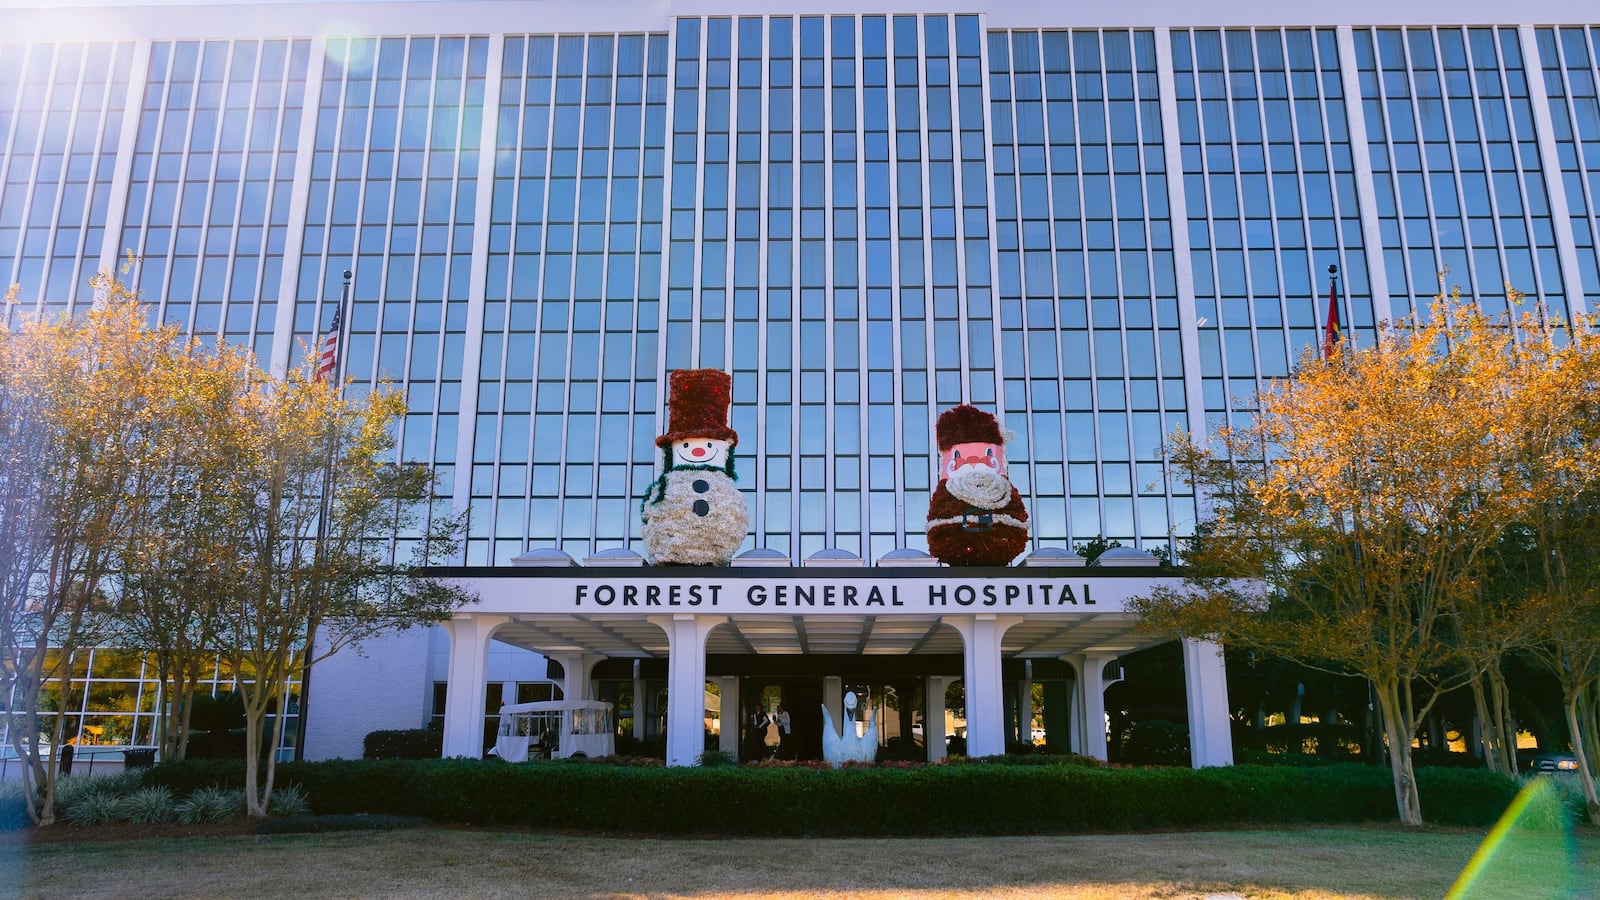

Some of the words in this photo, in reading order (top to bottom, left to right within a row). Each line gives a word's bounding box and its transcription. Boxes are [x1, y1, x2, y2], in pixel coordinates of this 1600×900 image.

[576, 585, 723, 606] FORREST
[747, 585, 904, 606] GENERAL
[929, 584, 1097, 606] HOSPITAL
